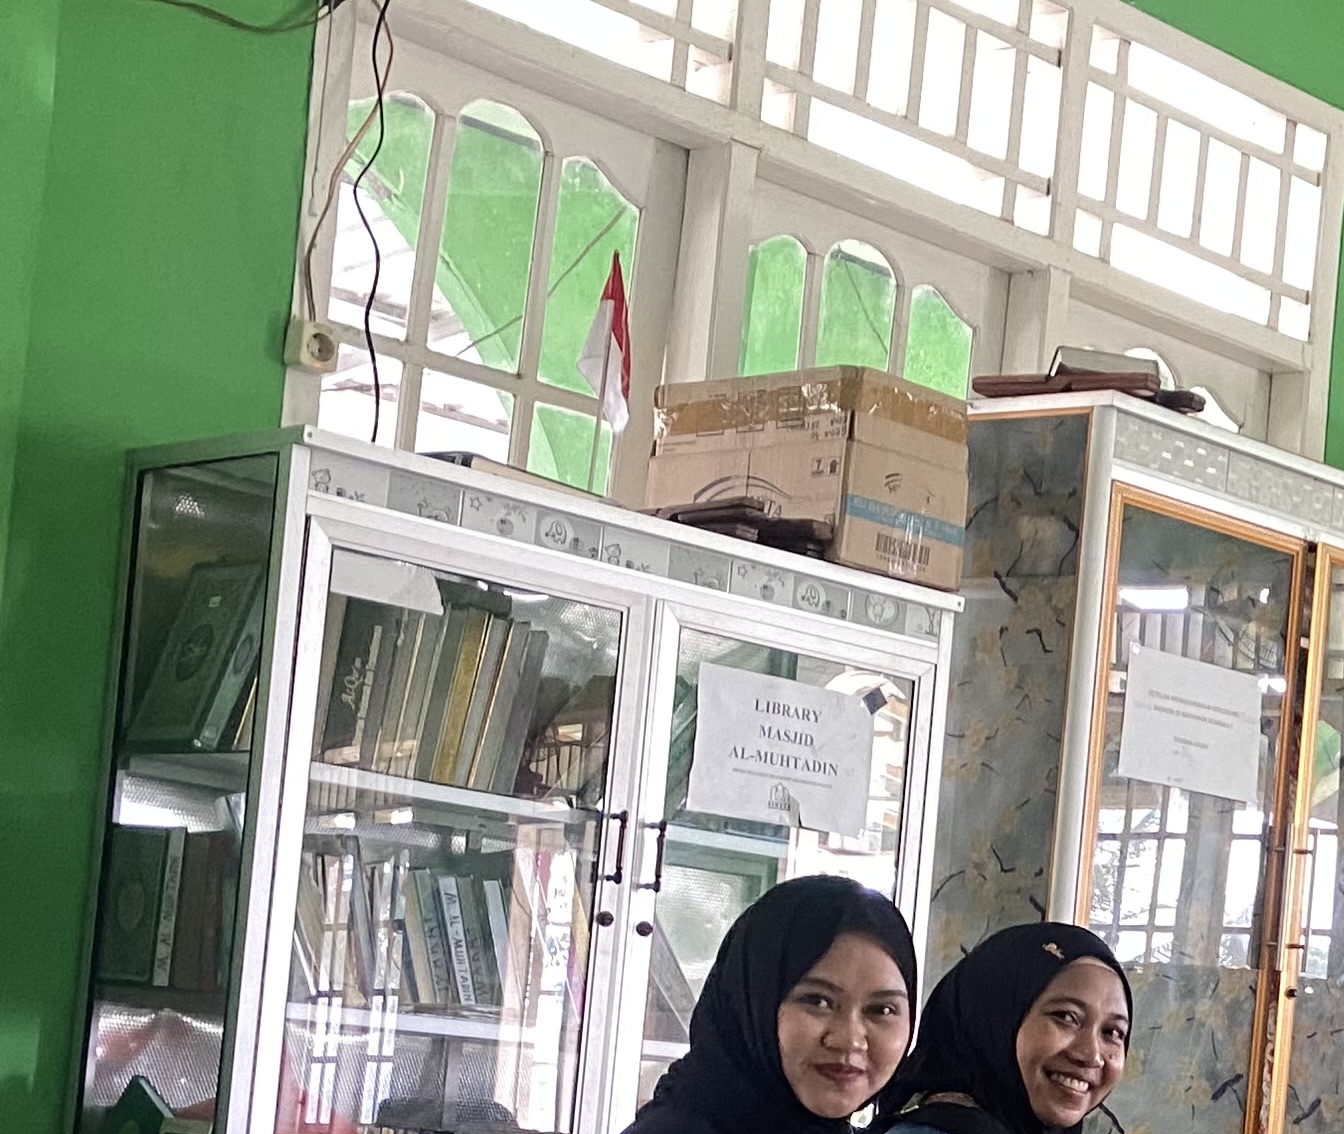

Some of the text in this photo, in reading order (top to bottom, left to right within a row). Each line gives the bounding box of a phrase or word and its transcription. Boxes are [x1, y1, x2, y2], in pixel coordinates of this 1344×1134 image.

[754, 698, 823, 723] LIBRARY
[758, 724, 815, 747] MASJID
[728, 746, 839, 776] AL-MUHTADIN
